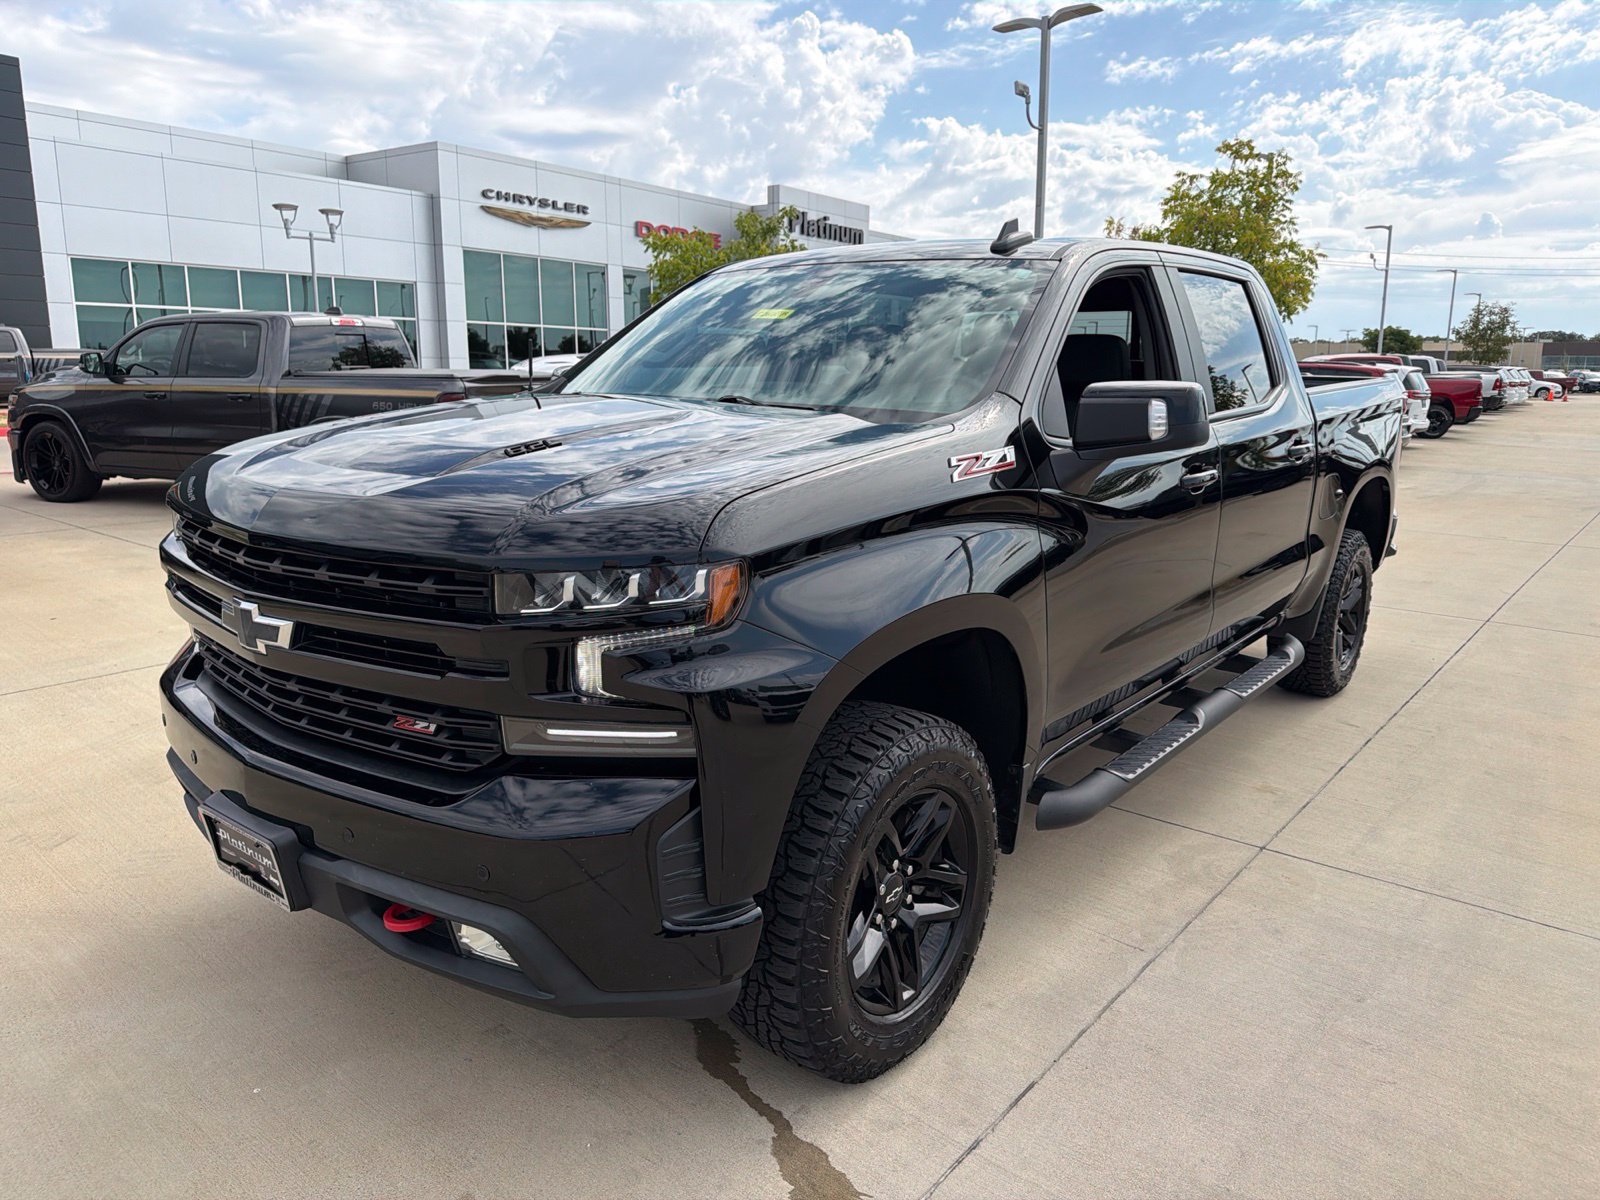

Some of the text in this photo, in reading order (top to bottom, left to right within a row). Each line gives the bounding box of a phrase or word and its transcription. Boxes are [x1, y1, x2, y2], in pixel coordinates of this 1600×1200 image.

[481, 188, 590, 215] CHRYSLER
[788, 211, 864, 245] Platinum
[372, 401, 393, 411] 650
[947, 445, 1016, 483] Z71
[216, 828, 277, 873] Platinum
